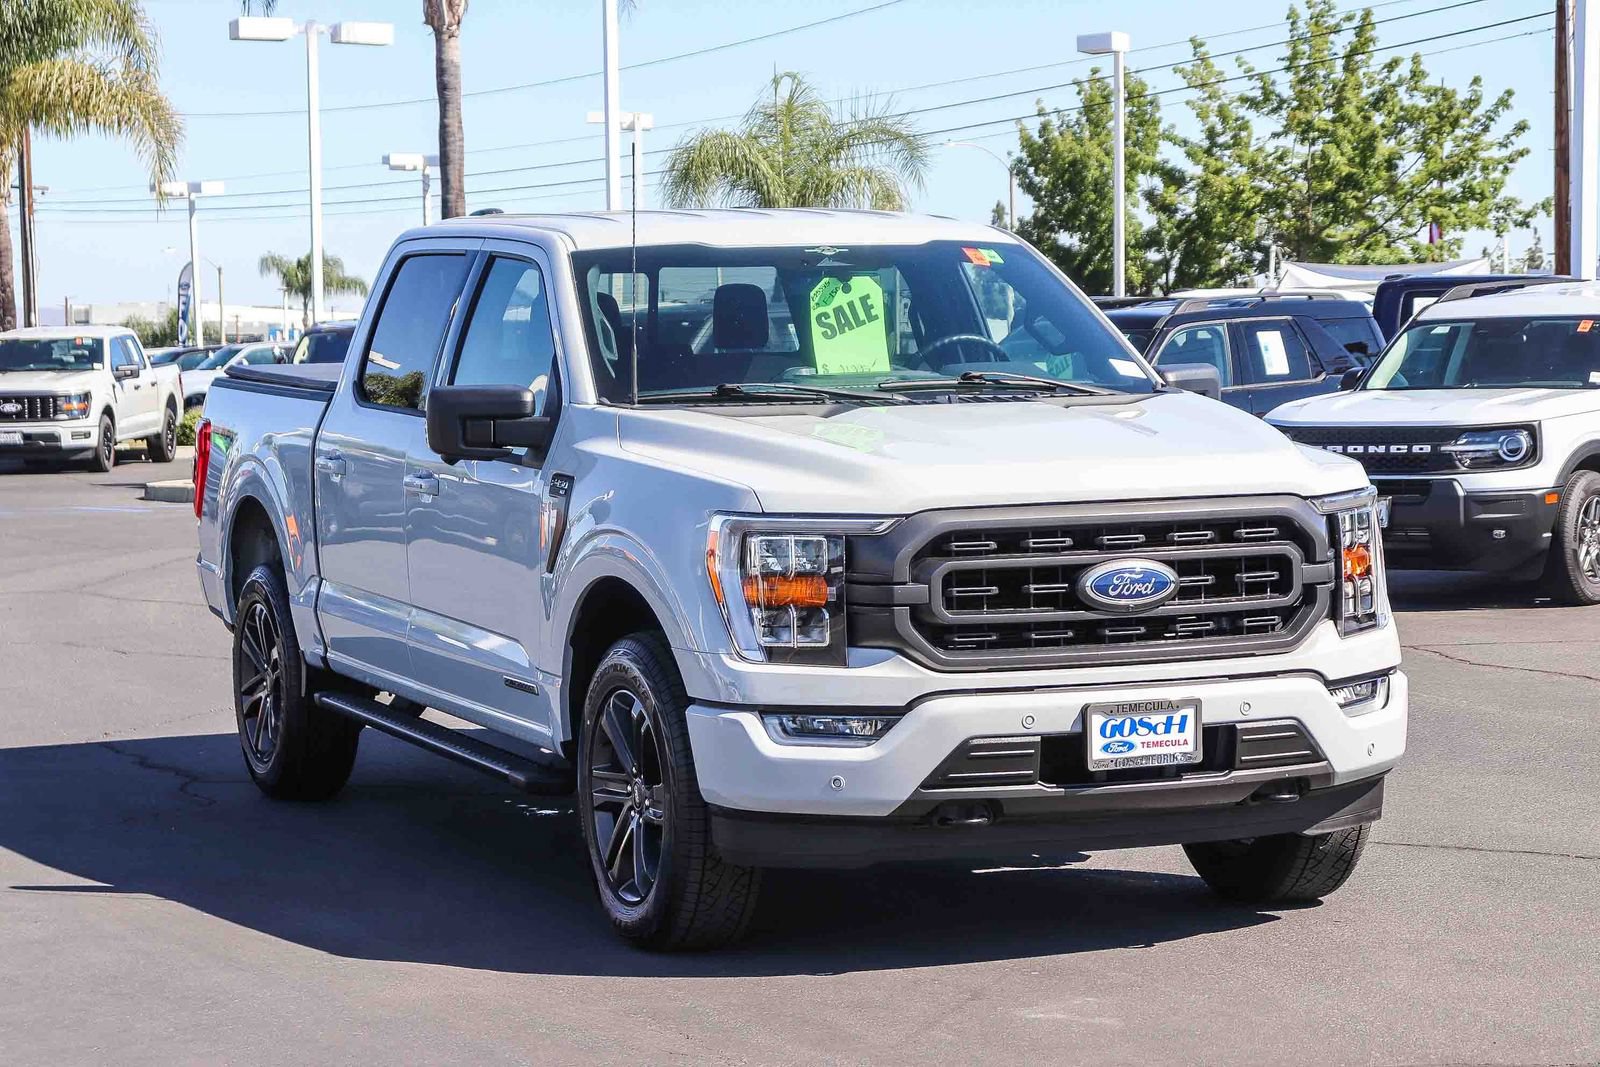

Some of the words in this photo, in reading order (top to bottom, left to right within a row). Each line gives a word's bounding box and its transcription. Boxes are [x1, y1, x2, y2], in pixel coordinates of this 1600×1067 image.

[815, 293, 880, 340] SALE
[1108, 572, 1156, 597] Ford
[1115, 701, 1175, 714] TEMECULA
[1107, 742, 1130, 753] Ford
[1140, 738, 1189, 749] TEMECULA
